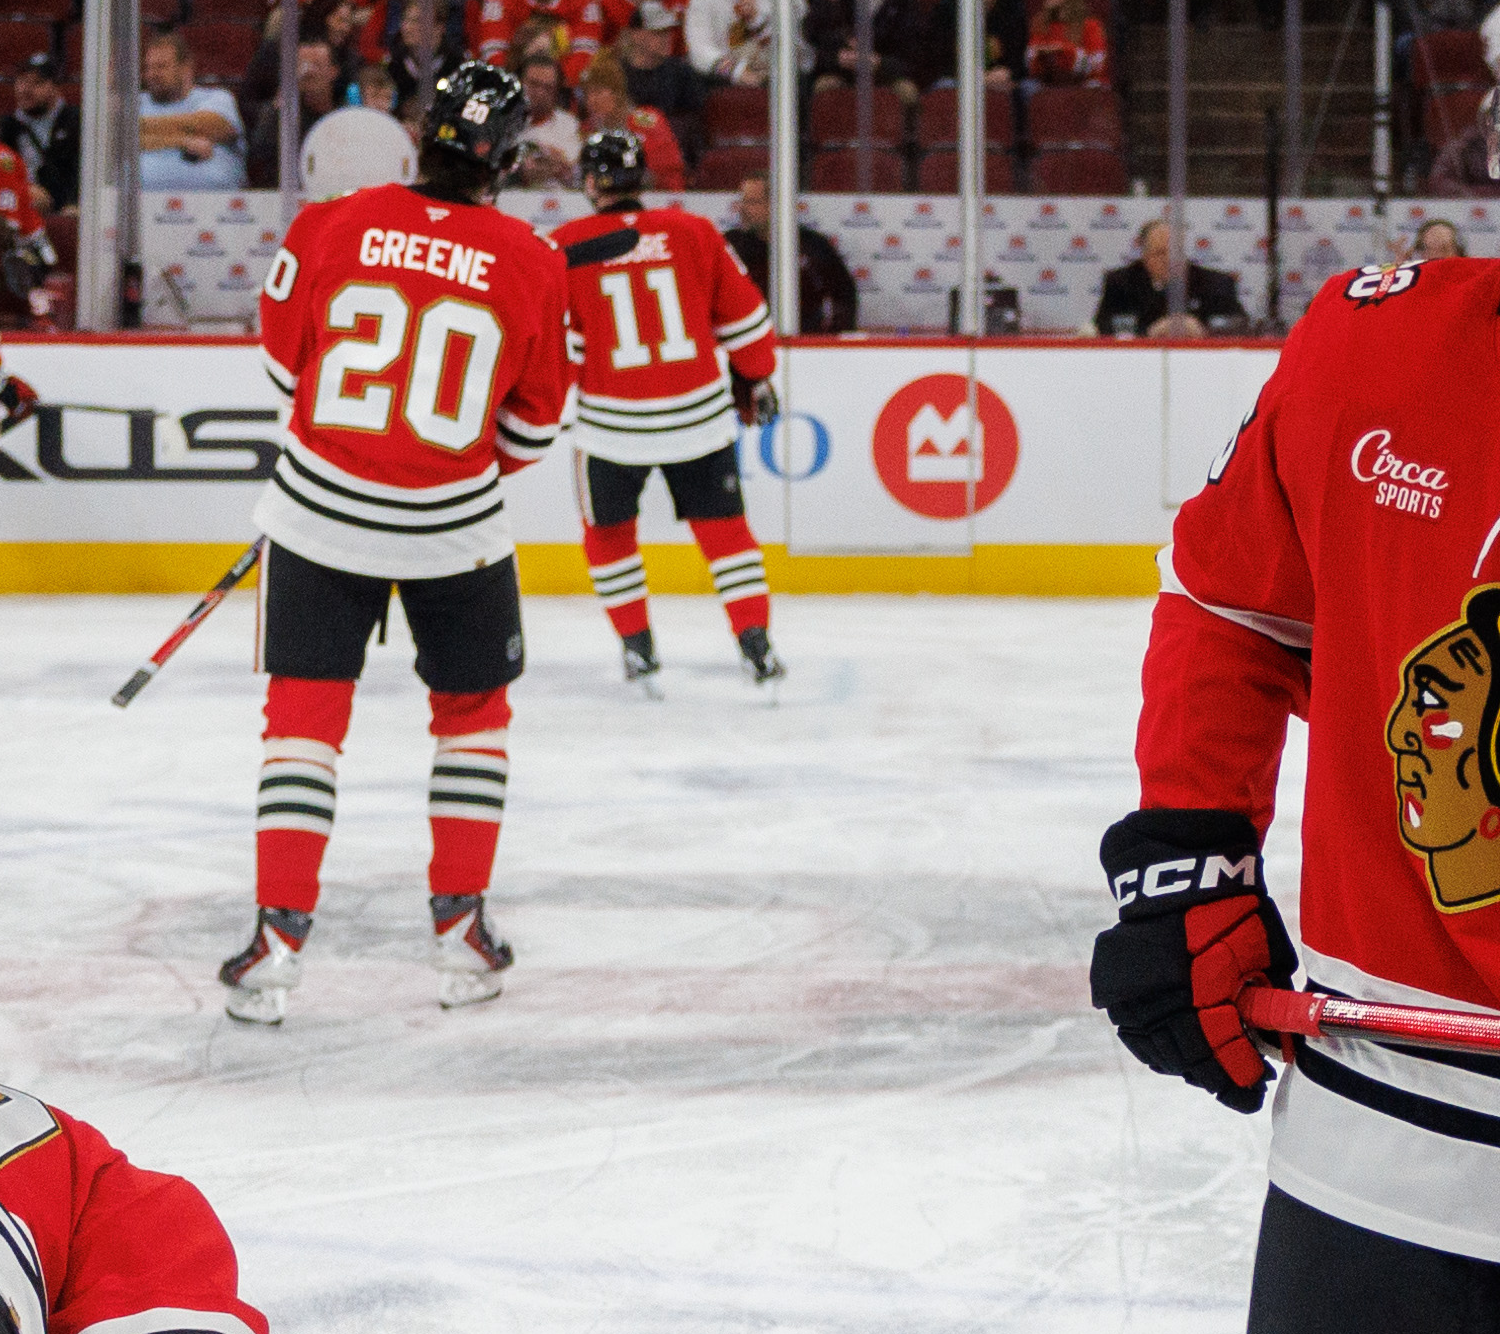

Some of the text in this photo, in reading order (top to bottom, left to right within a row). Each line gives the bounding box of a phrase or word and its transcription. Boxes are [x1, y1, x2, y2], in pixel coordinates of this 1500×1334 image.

[461, 98, 491, 125] 20
[358, 227, 497, 292] GREENE
[600, 268, 699, 370] 11
[311, 282, 505, 454] 20
[1351, 429, 1449, 491] Circa
[1375, 481, 1443, 519] SPORTS
[1114, 854, 1257, 908] CCM
